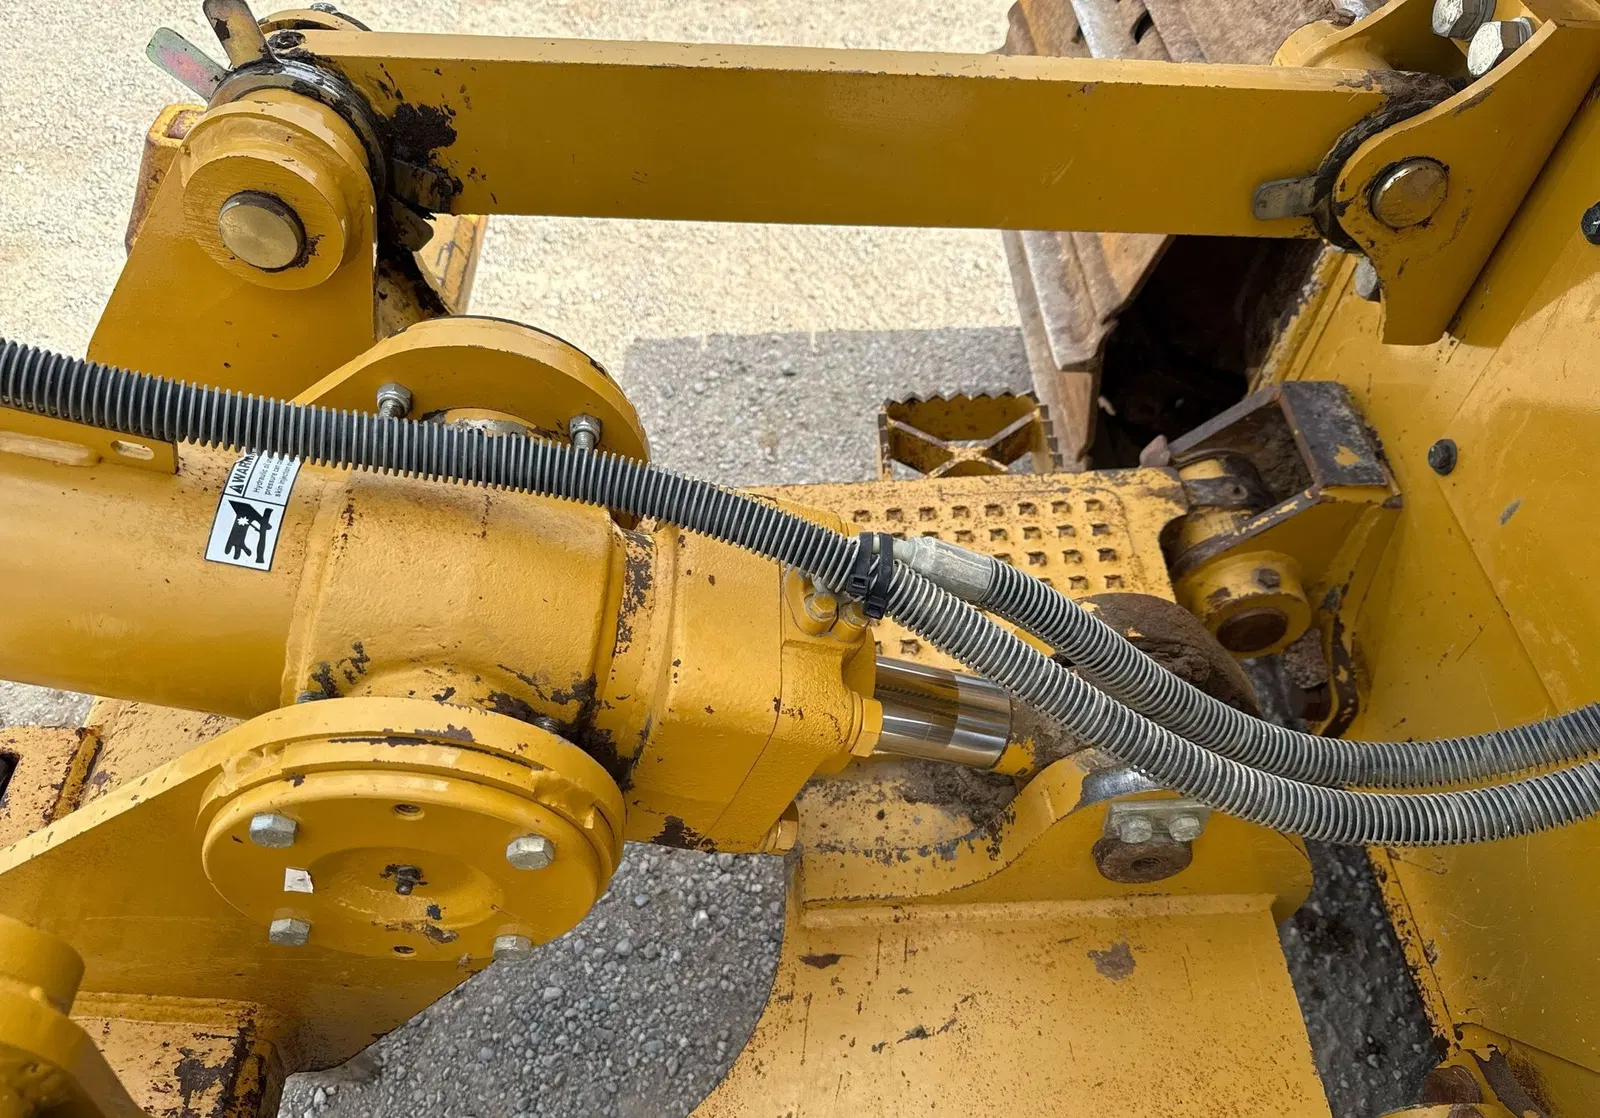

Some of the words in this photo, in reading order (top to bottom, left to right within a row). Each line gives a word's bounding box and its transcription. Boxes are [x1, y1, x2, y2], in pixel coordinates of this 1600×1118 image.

[232, 452, 256, 482] WARNI
[253, 469, 268, 493] Hydraulic
[265, 473, 277, 496] pressure
[274, 485, 283, 498] skin
[279, 466, 290, 485] injection
